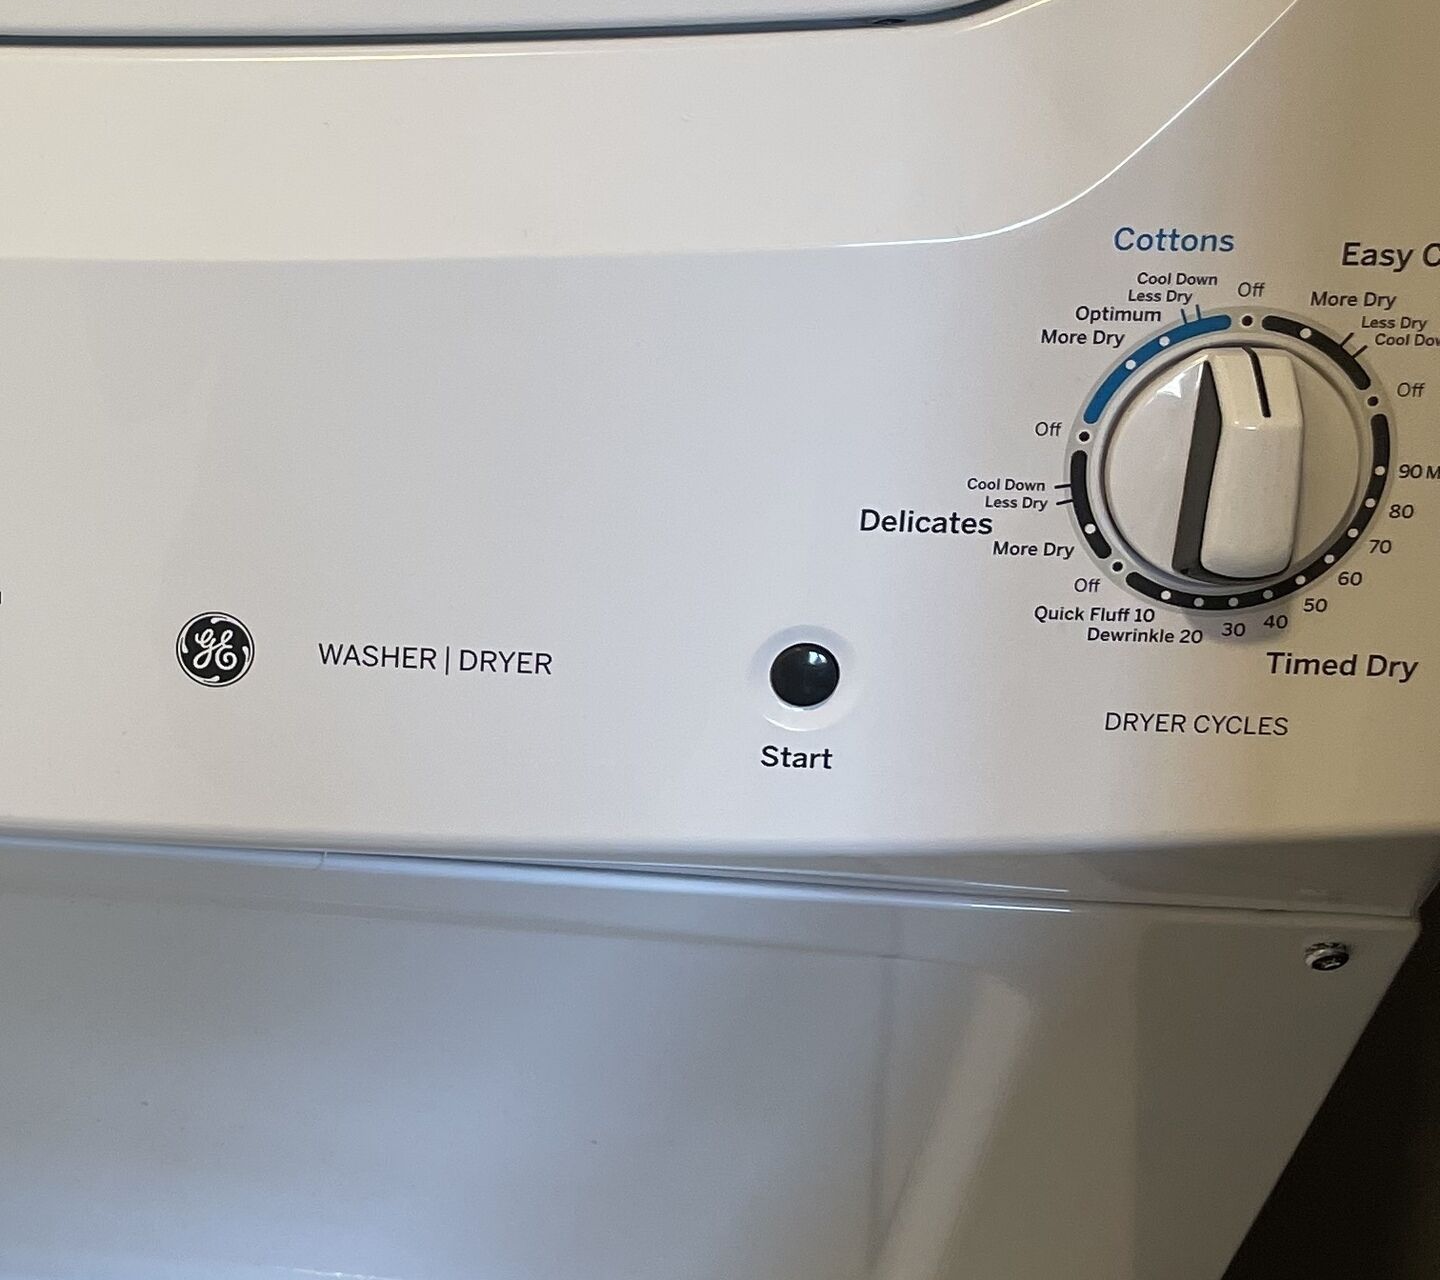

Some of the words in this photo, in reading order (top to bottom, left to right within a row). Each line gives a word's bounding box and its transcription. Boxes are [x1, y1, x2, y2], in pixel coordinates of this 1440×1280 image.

[1113, 227, 1235, 253] Cottons
[1342, 242, 1414, 273] Easy
[1137, 272, 1172, 286] Cool
[1175, 273, 1218, 287] Down
[1128, 289, 1162, 303] Less
[1166, 290, 1193, 305] Dry
[1238, 282, 1265, 298] Off
[1310, 291, 1358, 307] More
[1363, 291, 1397, 310] Dry
[1075, 306, 1162, 326] Optimum
[1361, 315, 1396, 329] Less
[1400, 316, 1428, 332] Dry
[1041, 330, 1089, 345] More
[1092, 330, 1126, 348] Dry
[1375, 333, 1410, 346] Cool
[1397, 382, 1426, 398] Off
[1035, 422, 1062, 437] Off
[1399, 464, 1423, 479] 90
[967, 478, 1001, 491] Cool
[1005, 478, 1046, 492] Down
[985, 496, 1016, 510] Less
[1018, 497, 1048, 512] Dry
[1389, 504, 1414, 520] 80
[859, 508, 993, 535] Delicates
[993, 541, 1038, 557] More
[1043, 543, 1075, 561] Dry
[1368, 539, 1393, 555] 70
[1074, 578, 1101, 593] Off
[1337, 571, 1363, 587] 60
[1303, 598, 1328, 613] 50
[1034, 605, 1085, 623] Quick
[1090, 607, 1130, 623] Fluff
[1134, 608, 1156, 623] 10
[1263, 614, 1288, 630] 40
[1087, 627, 1175, 644] Dewrinkle
[1179, 629, 1203, 644] 20
[1221, 622, 1246, 638] 30
[318, 643, 437, 670] WASHER
[459, 649, 552, 675] DRYER
[1266, 652, 1357, 677] Timed
[1365, 655, 1419, 683] Dry
[1105, 712, 1186, 733] DRYER
[1193, 715, 1289, 736] CYCLES
[760, 745, 833, 769] Start
